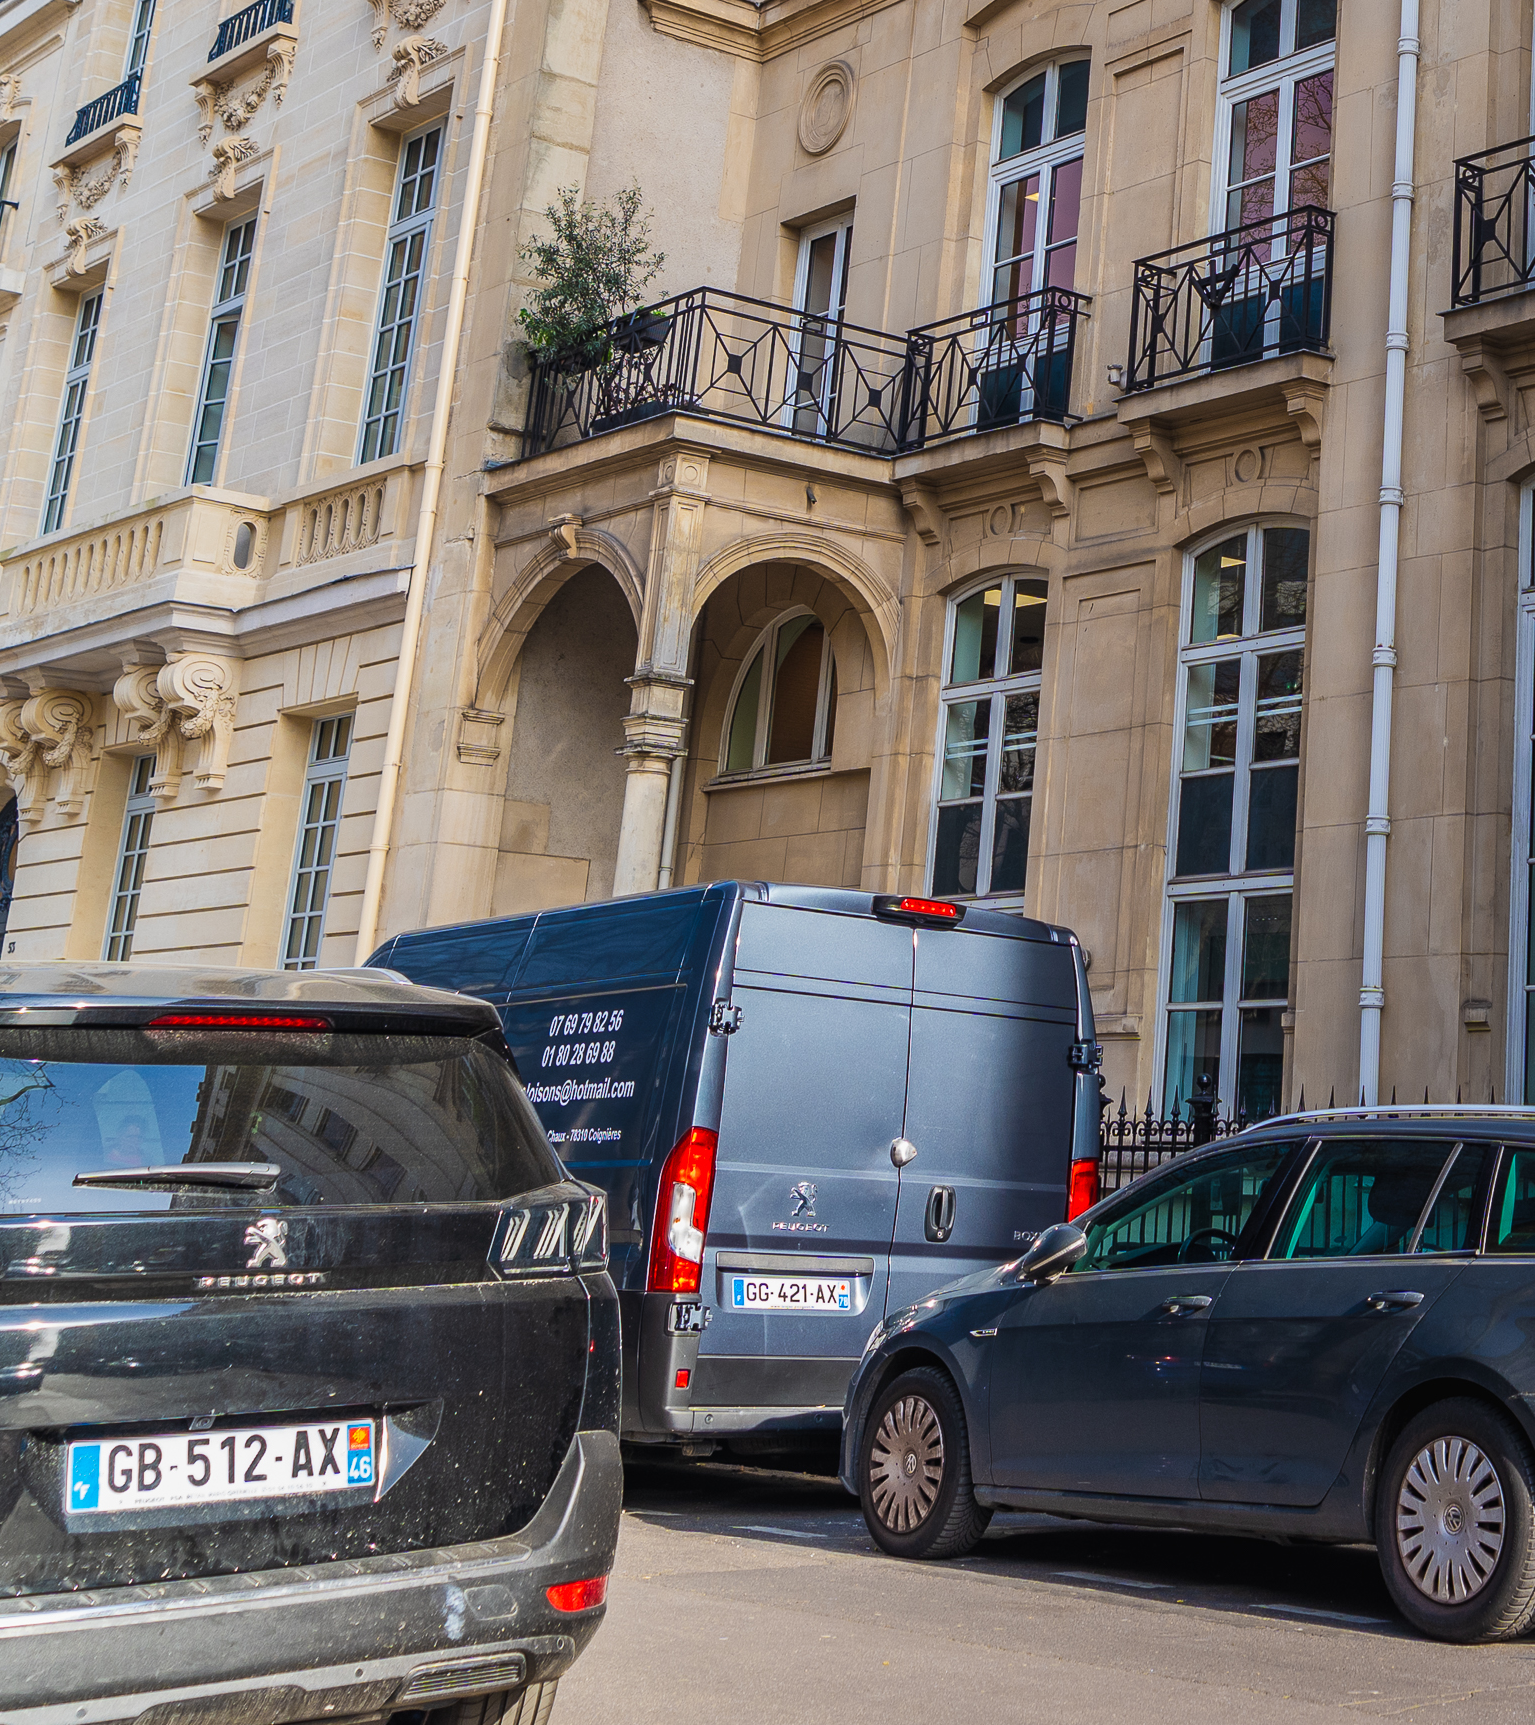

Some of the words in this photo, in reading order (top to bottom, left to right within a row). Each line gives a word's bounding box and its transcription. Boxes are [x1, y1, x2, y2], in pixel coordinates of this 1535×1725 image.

[549, 1015, 564, 1037] 07
[564, 1014, 579, 1036] 69
[579, 1012, 593, 1034] 79
[593, 1011, 608, 1033] 82
[608, 1009, 624, 1032] 56
[542, 1046, 556, 1068] 01
[556, 1044, 570, 1066] 80
[570, 1042, 586, 1066] 28
[586, 1042, 600, 1064] 69
[600, 1040, 616, 1063] 88
[570, 1128, 588, 1142] 78310
[588, 1126, 622, 1145] Coignières
[772, 1221, 830, 1232] PEUGEOT
[1013, 1230, 1042, 1242] BOX
[196, 1272, 321, 1288] PEUGEOT
[746, 1282, 837, 1304] GG-421-AX
[107, 1427, 341, 1494] GB-512-AX
[349, 1455, 371, 1480] 46
